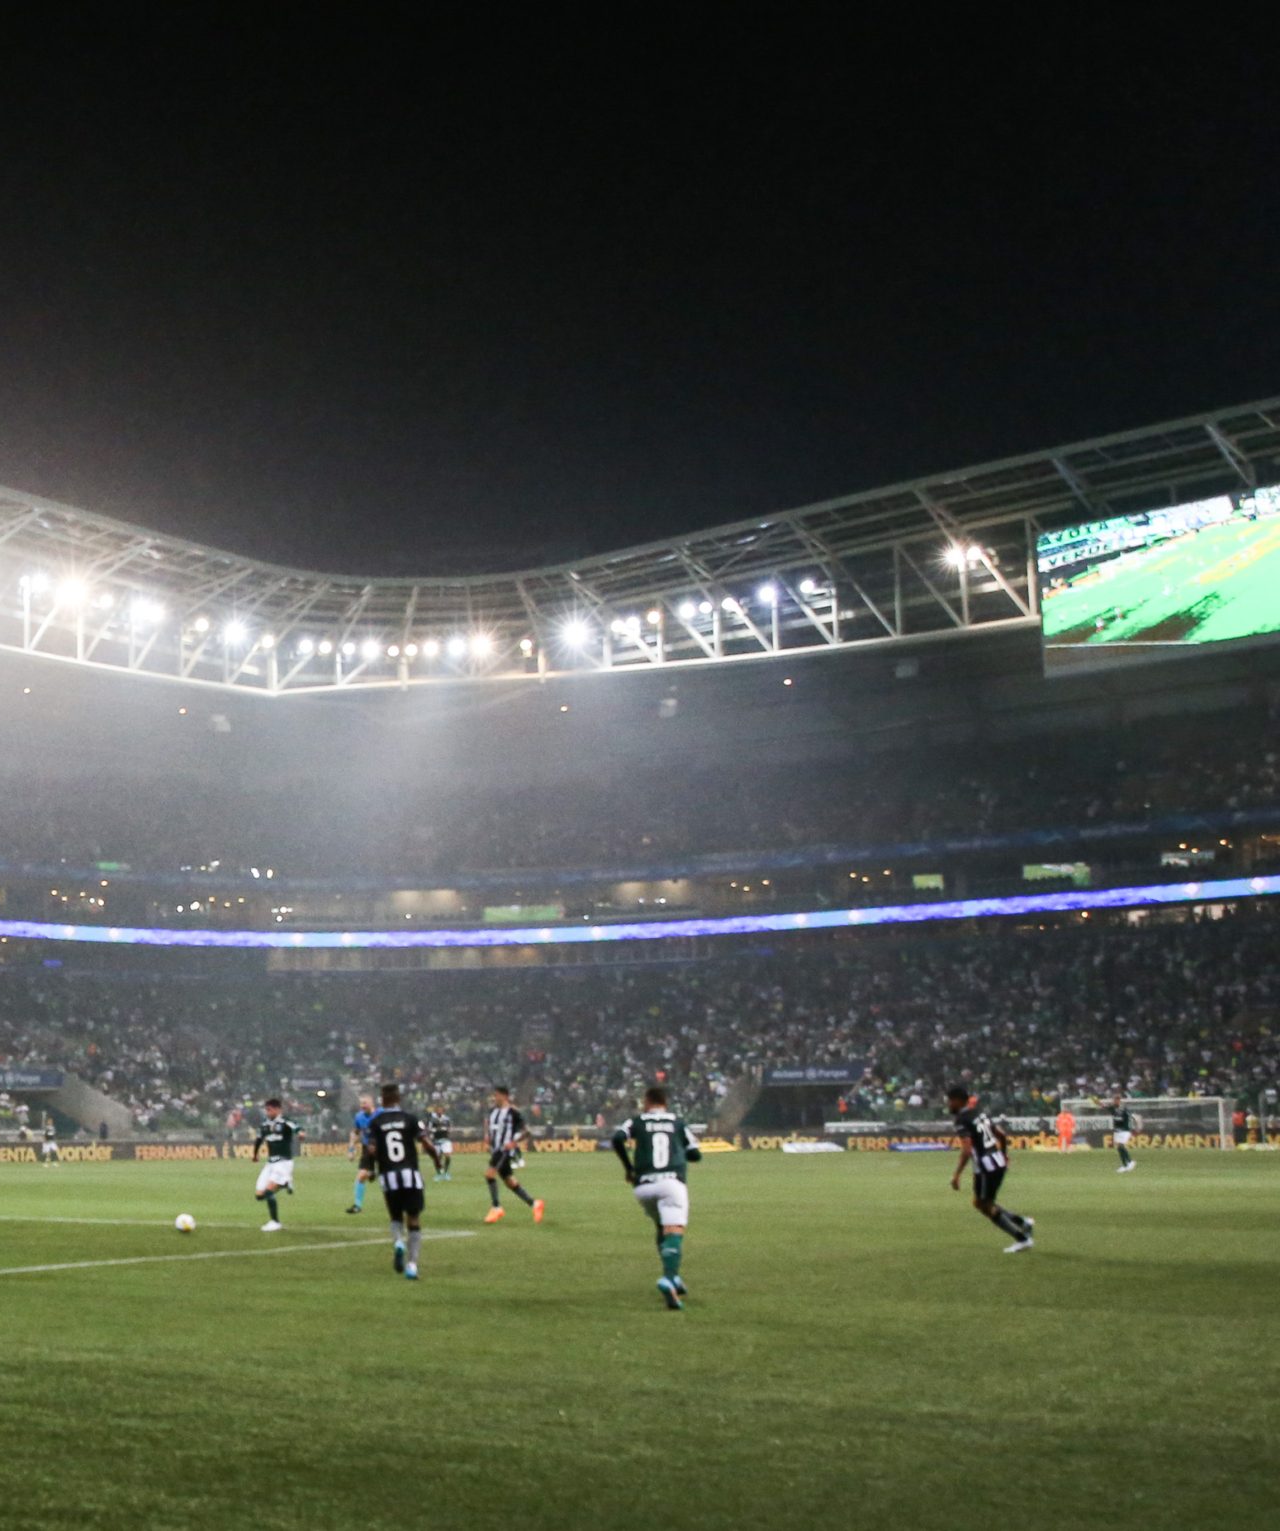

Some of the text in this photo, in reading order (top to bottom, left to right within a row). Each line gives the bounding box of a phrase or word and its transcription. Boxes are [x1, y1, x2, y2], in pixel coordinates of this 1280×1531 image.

[56, 1141, 114, 1161] vonder
[386, 1131, 405, 1163] 6
[533, 1135, 597, 1153] vonder
